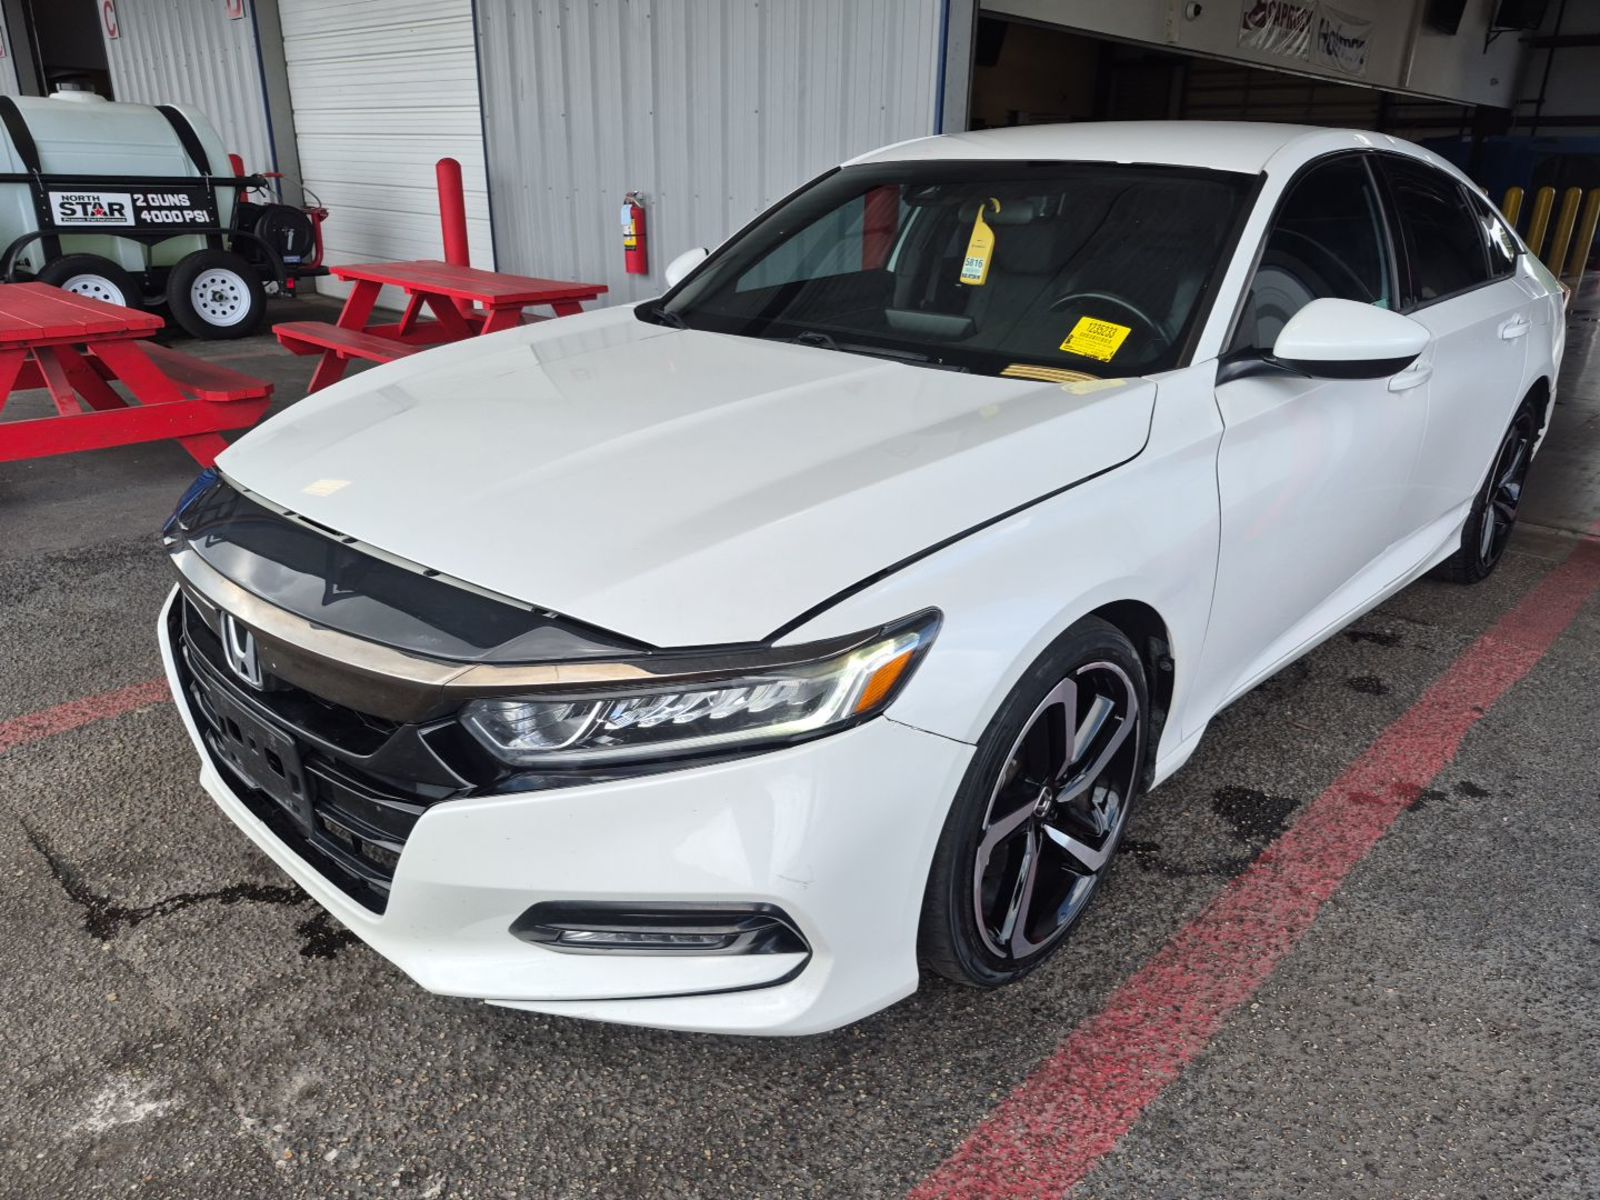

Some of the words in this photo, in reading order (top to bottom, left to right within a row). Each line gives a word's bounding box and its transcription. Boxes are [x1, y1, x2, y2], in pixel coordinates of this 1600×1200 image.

[104, 1, 117, 36] C
[133, 194, 147, 207] 2
[149, 194, 191, 207] GUNS
[59, 202, 125, 217] STAR
[141, 210, 184, 223] 4000
[185, 211, 210, 223] PSI
[965, 258, 984, 268] 5816
